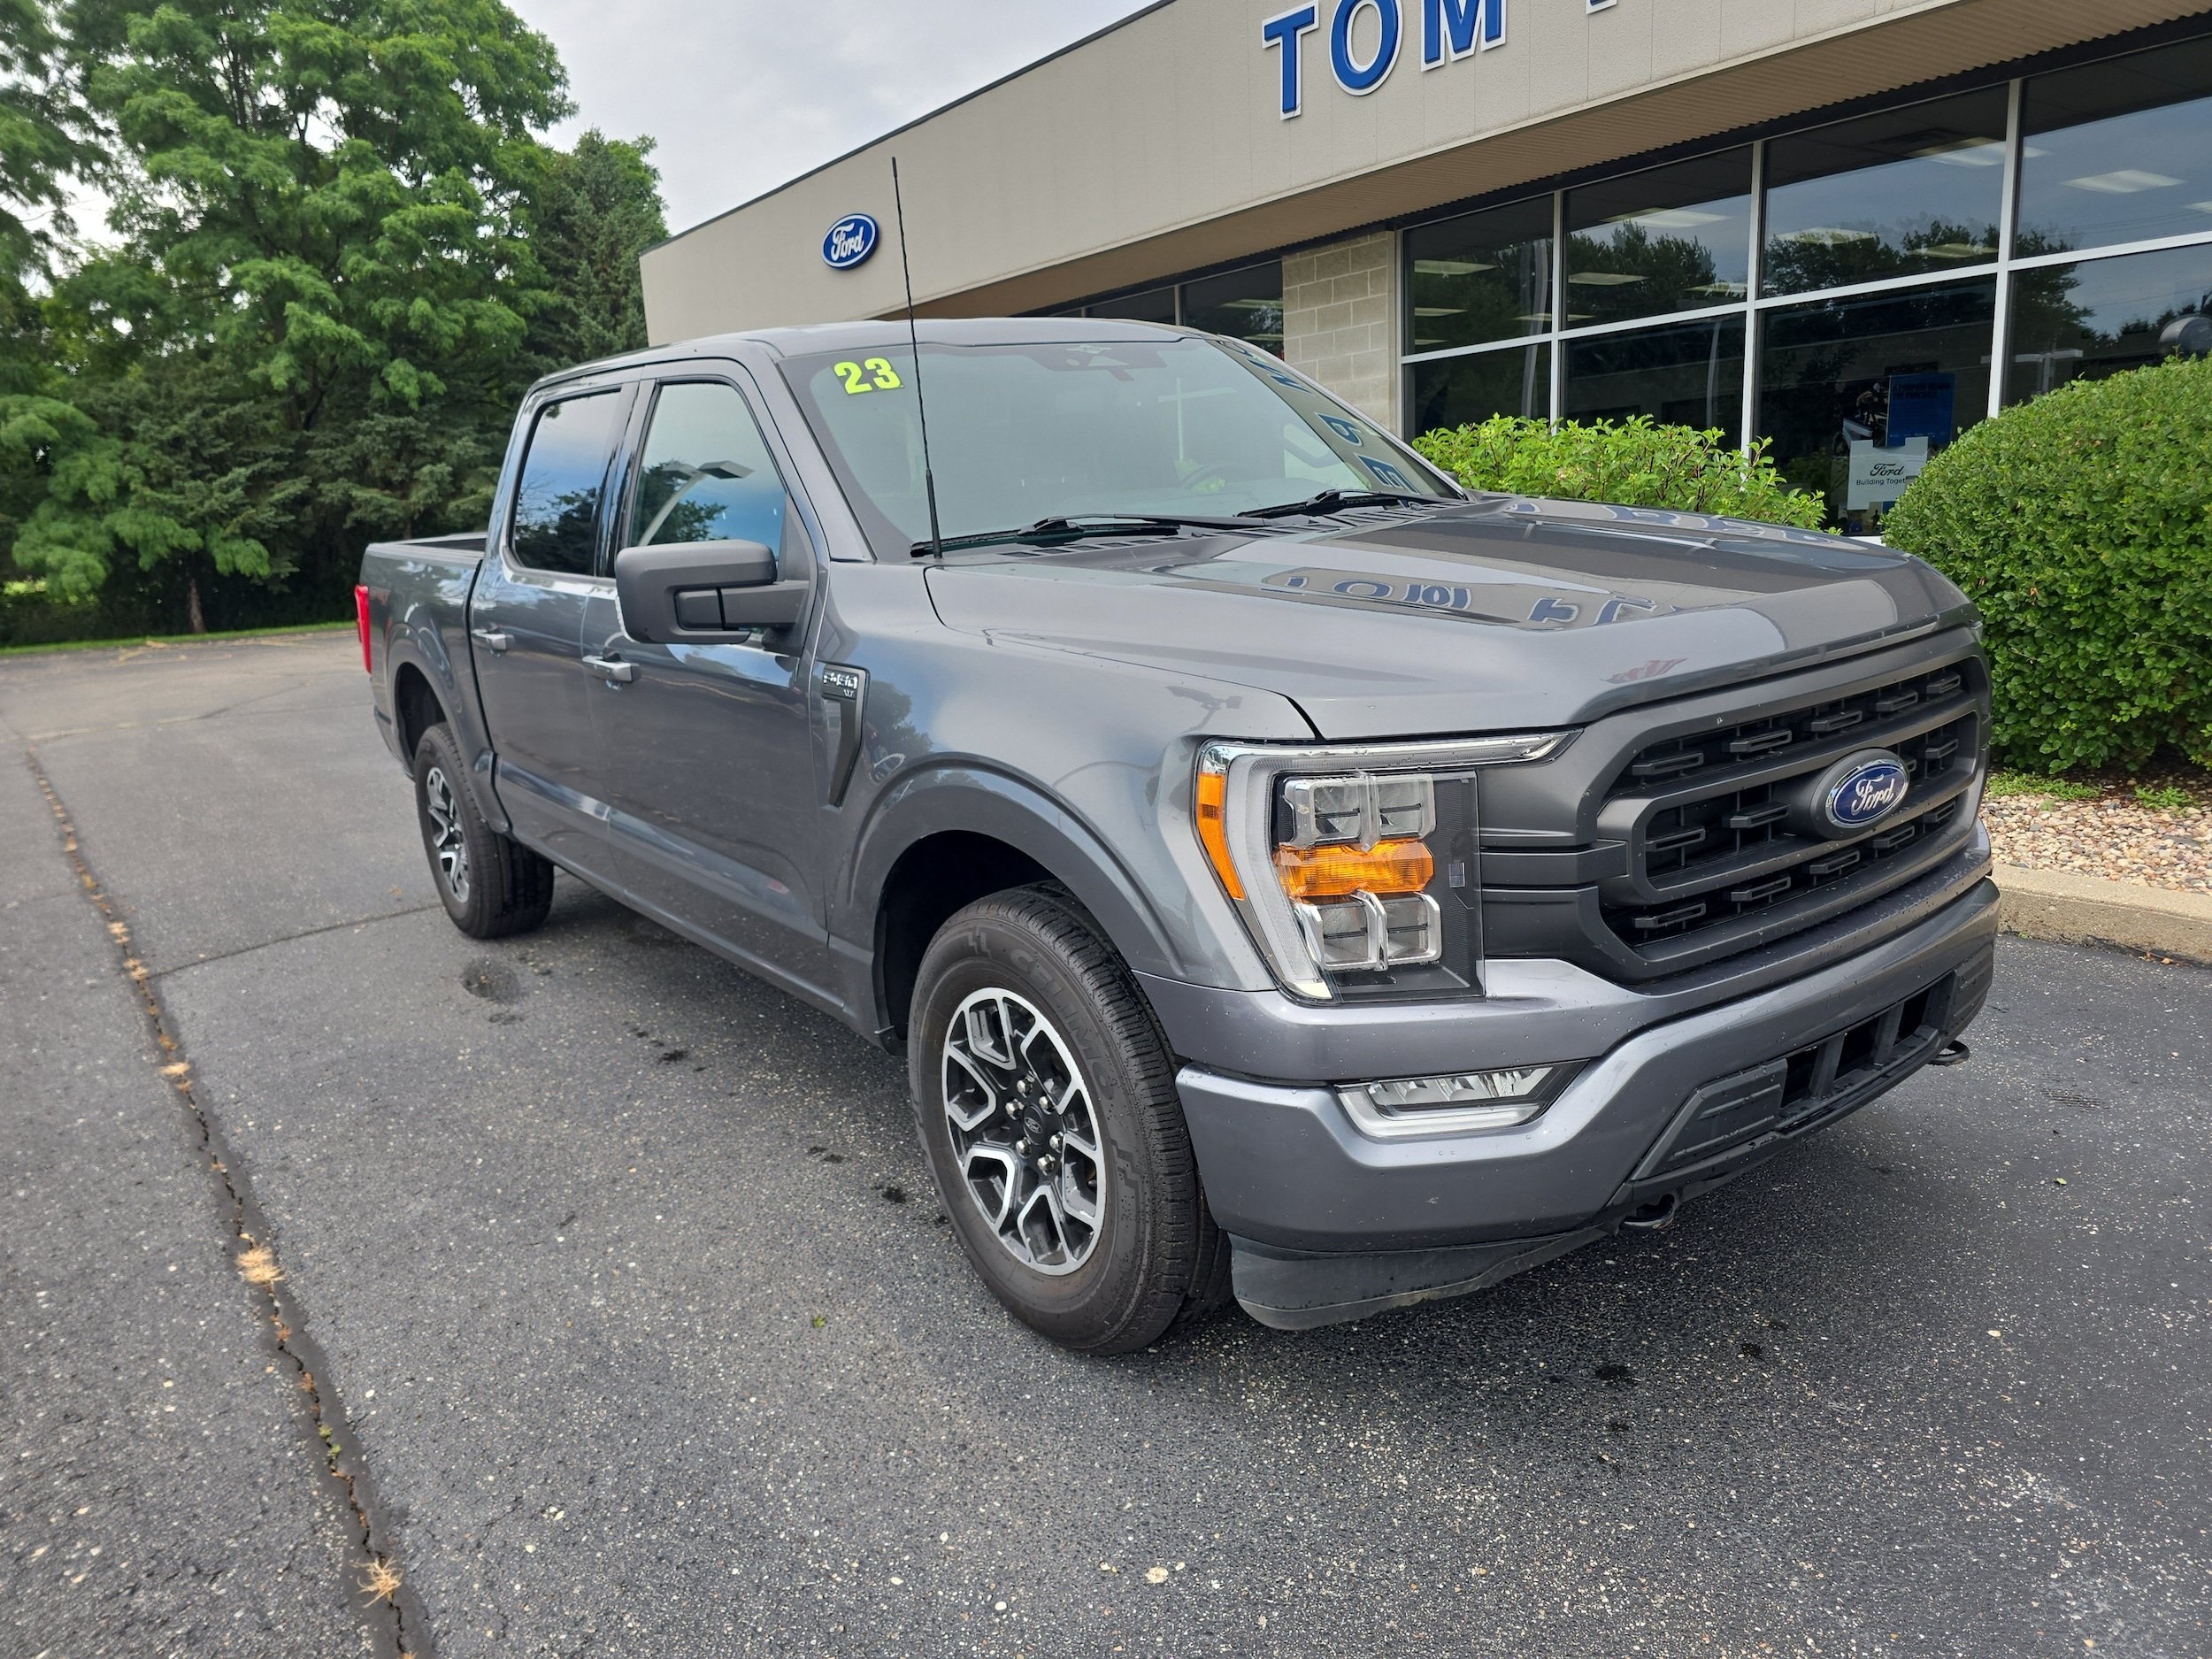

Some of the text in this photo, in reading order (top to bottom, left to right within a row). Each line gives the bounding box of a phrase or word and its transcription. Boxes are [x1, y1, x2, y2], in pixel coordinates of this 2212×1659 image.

[1263, 0, 1507, 120] TOM
[831, 222, 864, 261] Ford
[834, 357, 901, 395] 23
[1870, 463, 1905, 477] Ford
[1851, 773, 1895, 816] Ford
